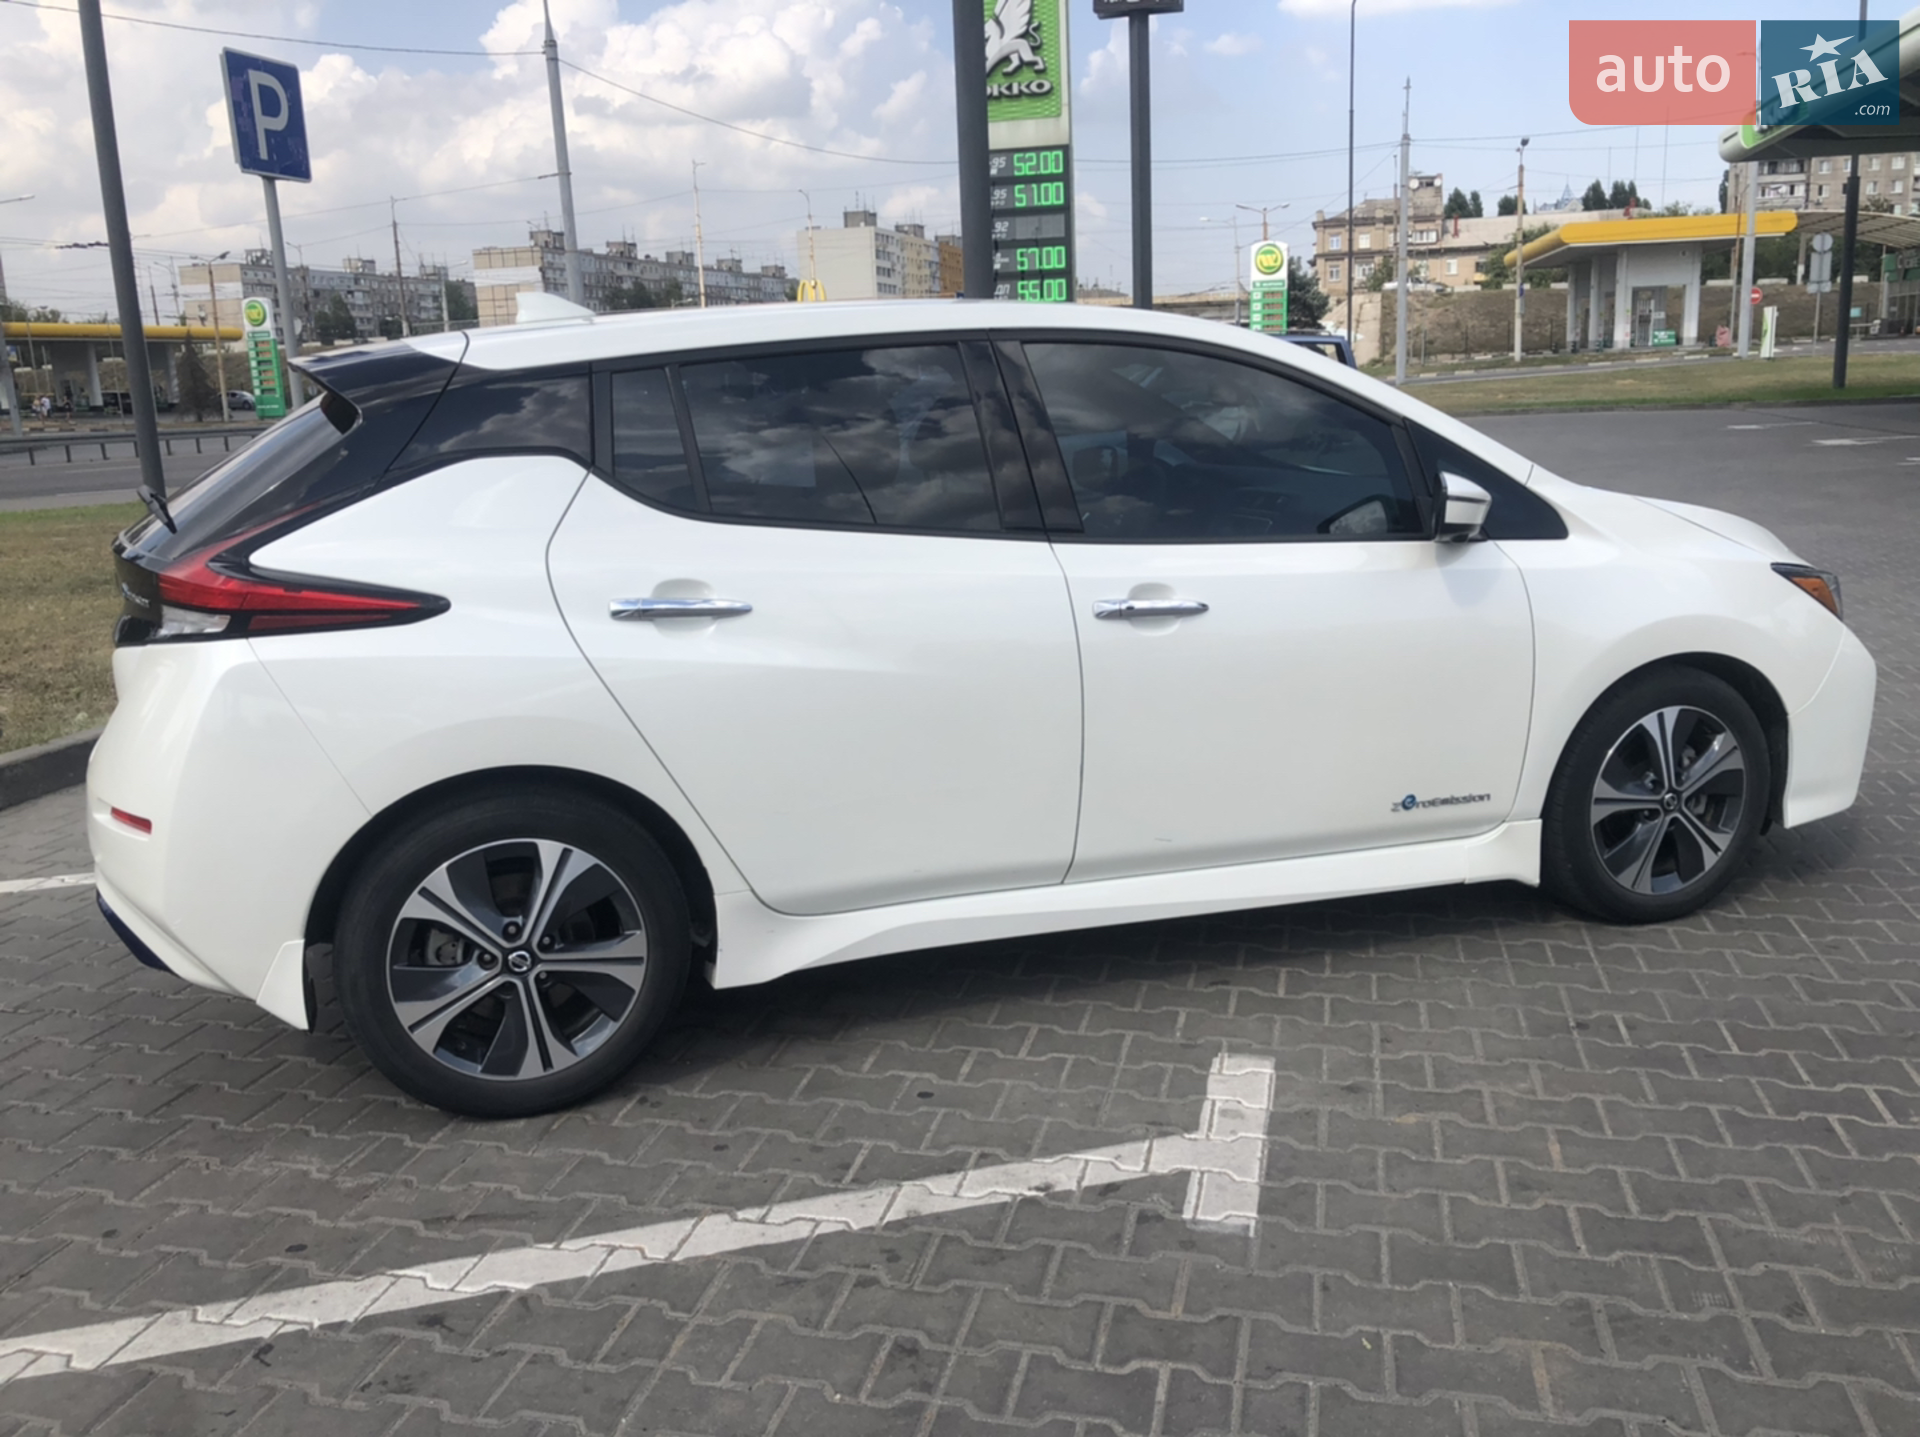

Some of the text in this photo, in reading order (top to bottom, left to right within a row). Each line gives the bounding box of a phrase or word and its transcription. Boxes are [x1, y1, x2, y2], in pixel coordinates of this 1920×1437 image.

[248, 69, 289, 161] P
[1013, 149, 1064, 176] 52.00
[1014, 182, 1065, 208] 51.00
[1016, 245, 1067, 271] 57.00
